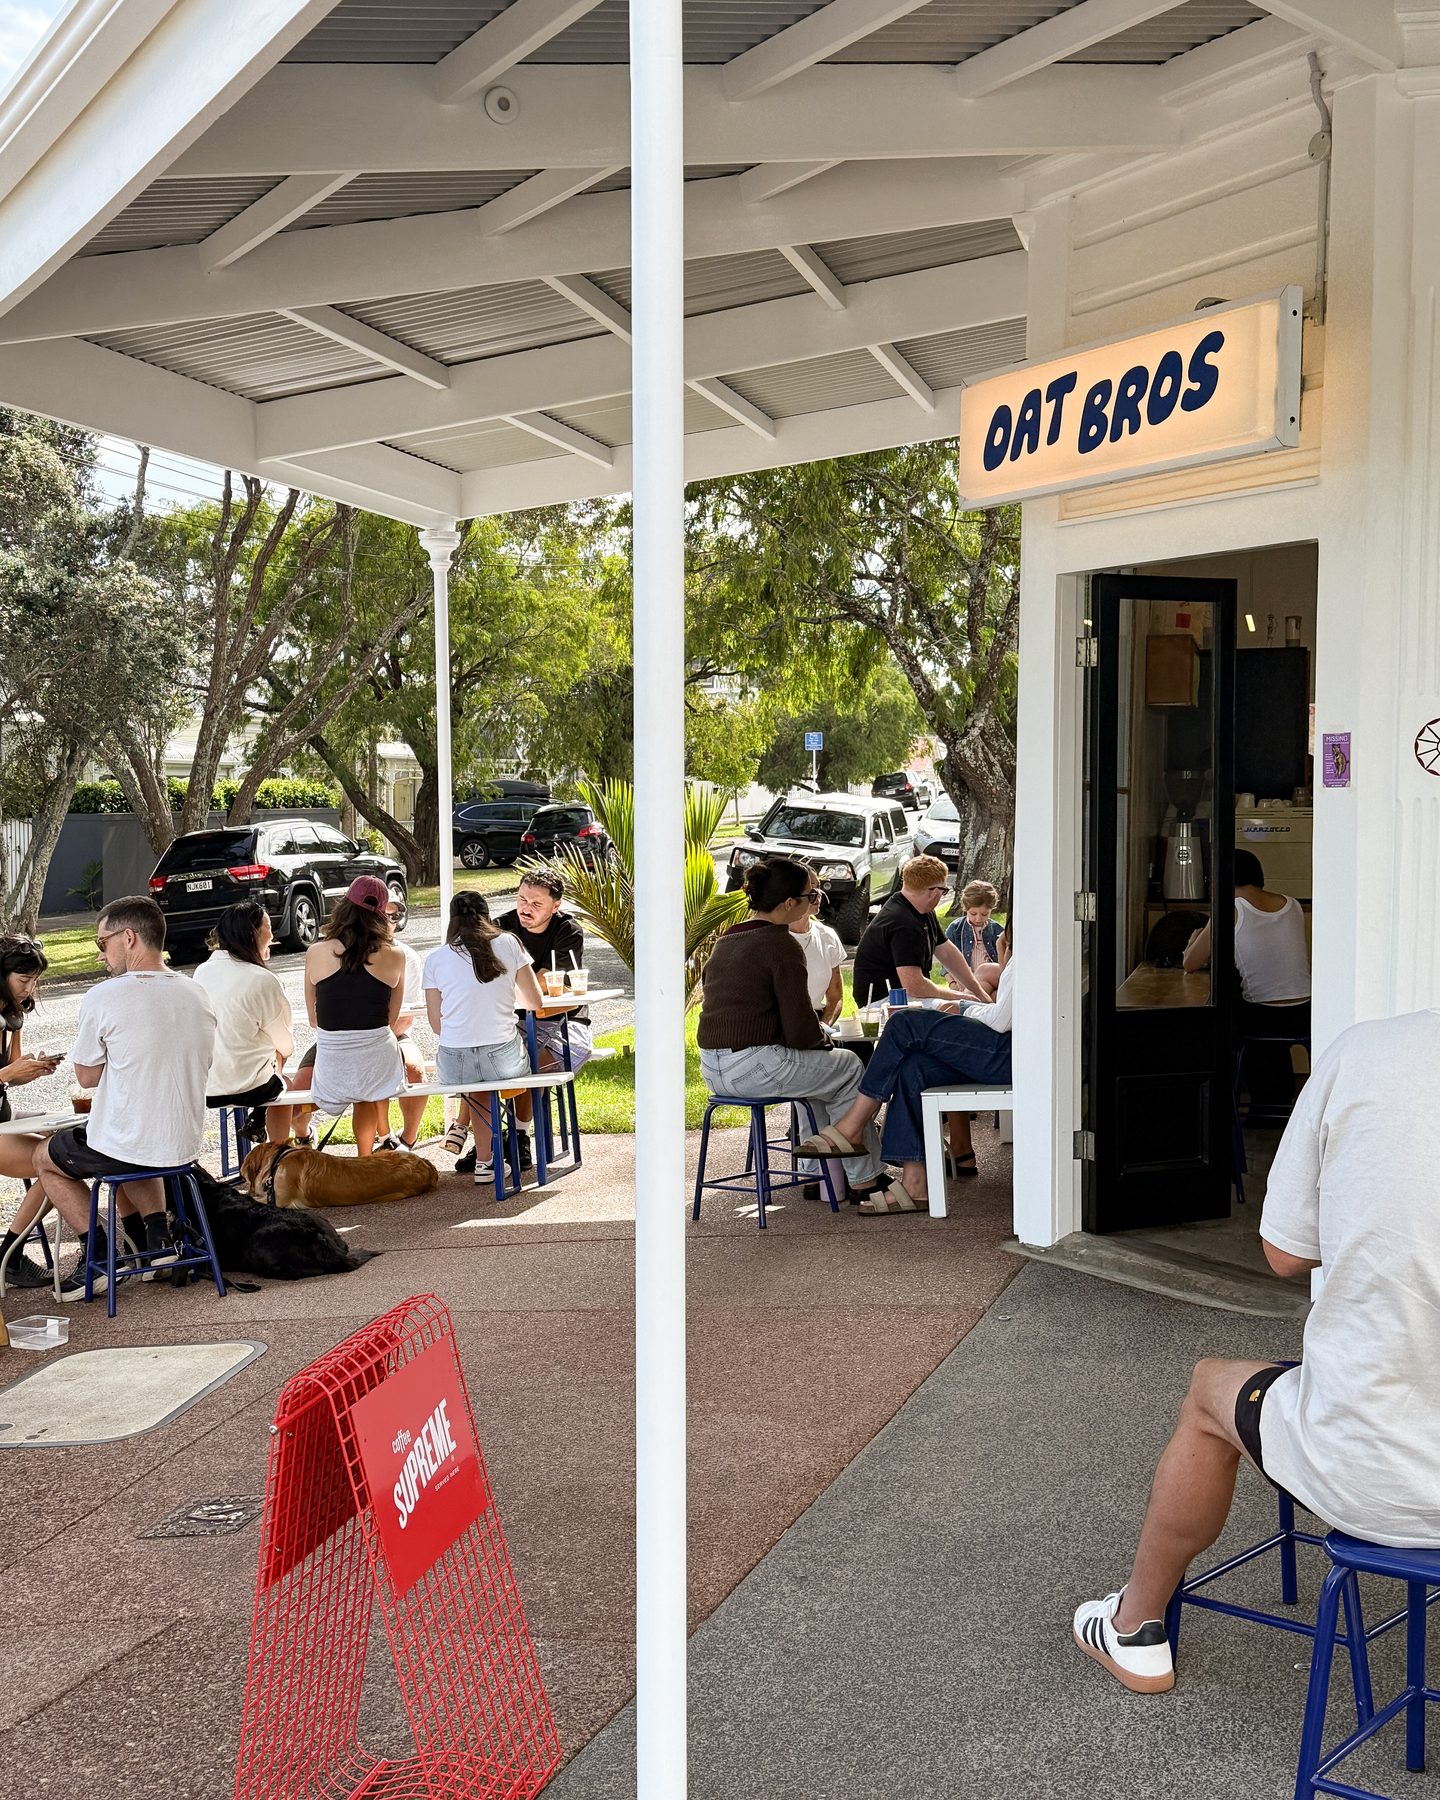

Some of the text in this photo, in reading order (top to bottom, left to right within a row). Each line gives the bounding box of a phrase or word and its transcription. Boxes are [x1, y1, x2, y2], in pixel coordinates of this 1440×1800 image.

[983, 331, 1225, 471] OAT BROS
[1325, 735, 1348, 743] MISSING
[392, 1429, 412, 1454] coffee
[393, 1397, 457, 1530] SUPREME
